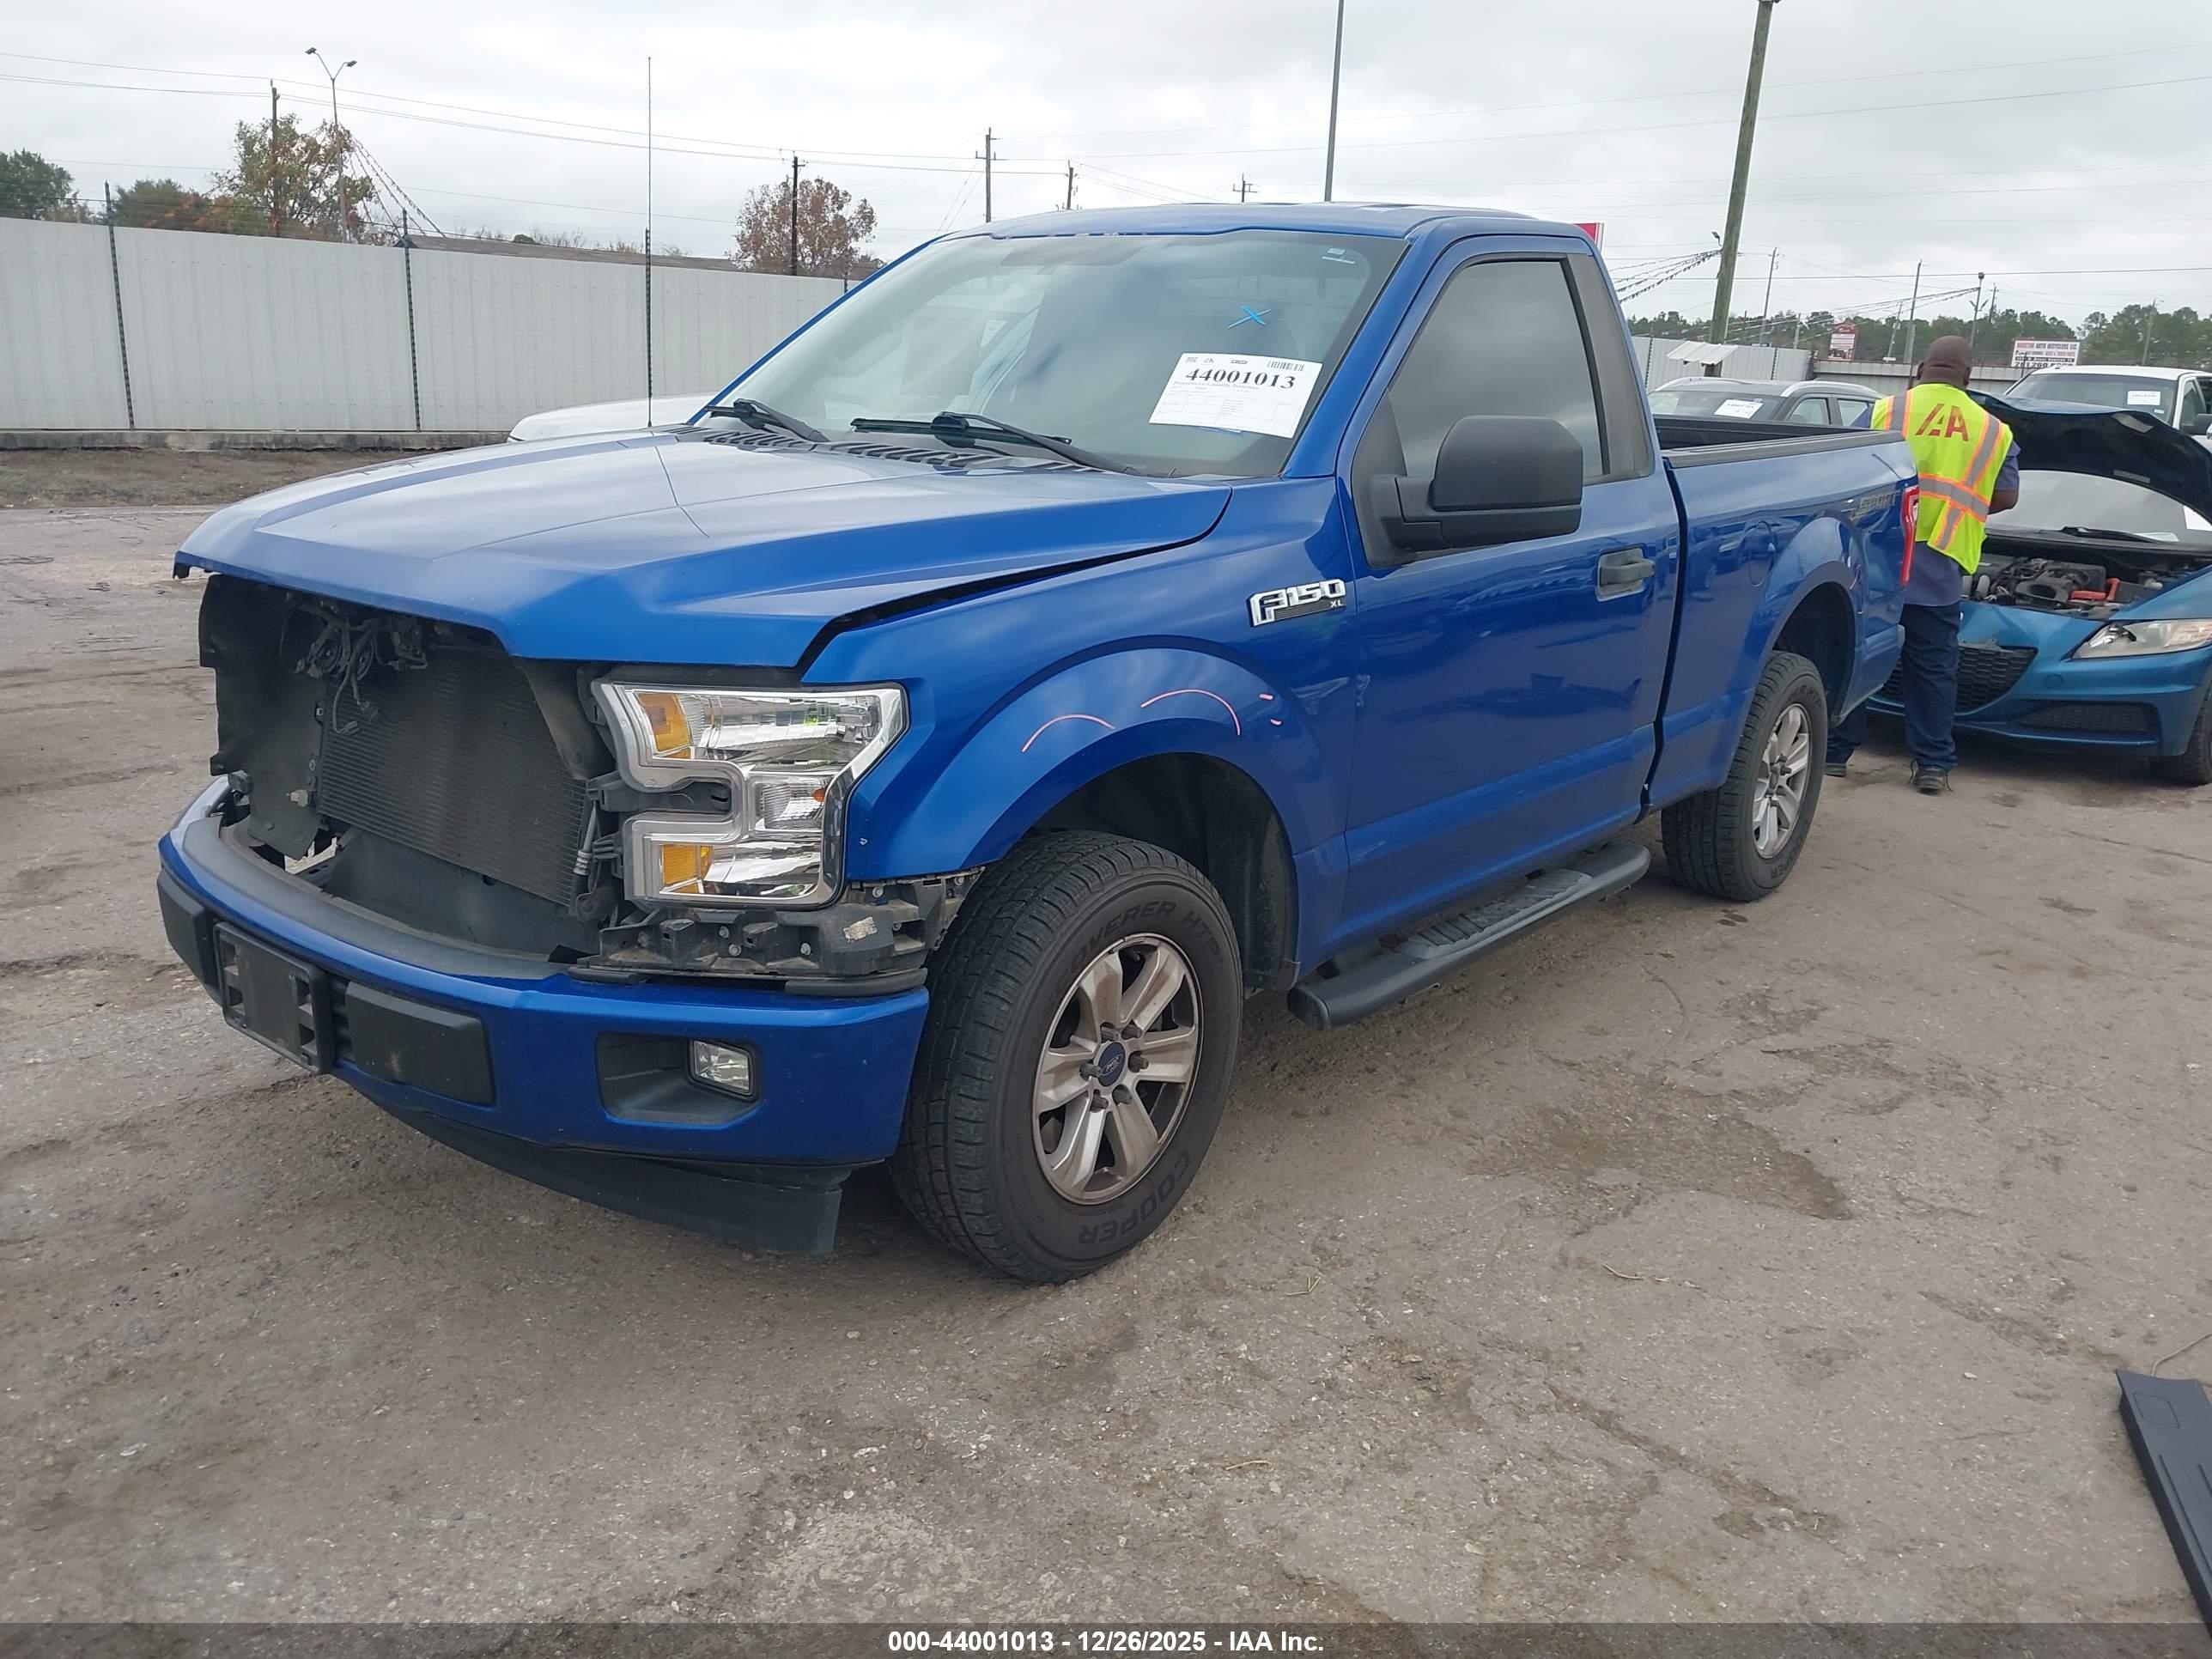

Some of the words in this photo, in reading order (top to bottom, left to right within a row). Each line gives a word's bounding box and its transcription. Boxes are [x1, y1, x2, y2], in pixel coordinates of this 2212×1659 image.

[1185, 368, 1296, 390] 44001013
[1330, 599, 1344, 608] XL
[1078, 1149, 1191, 1244] COOPER
